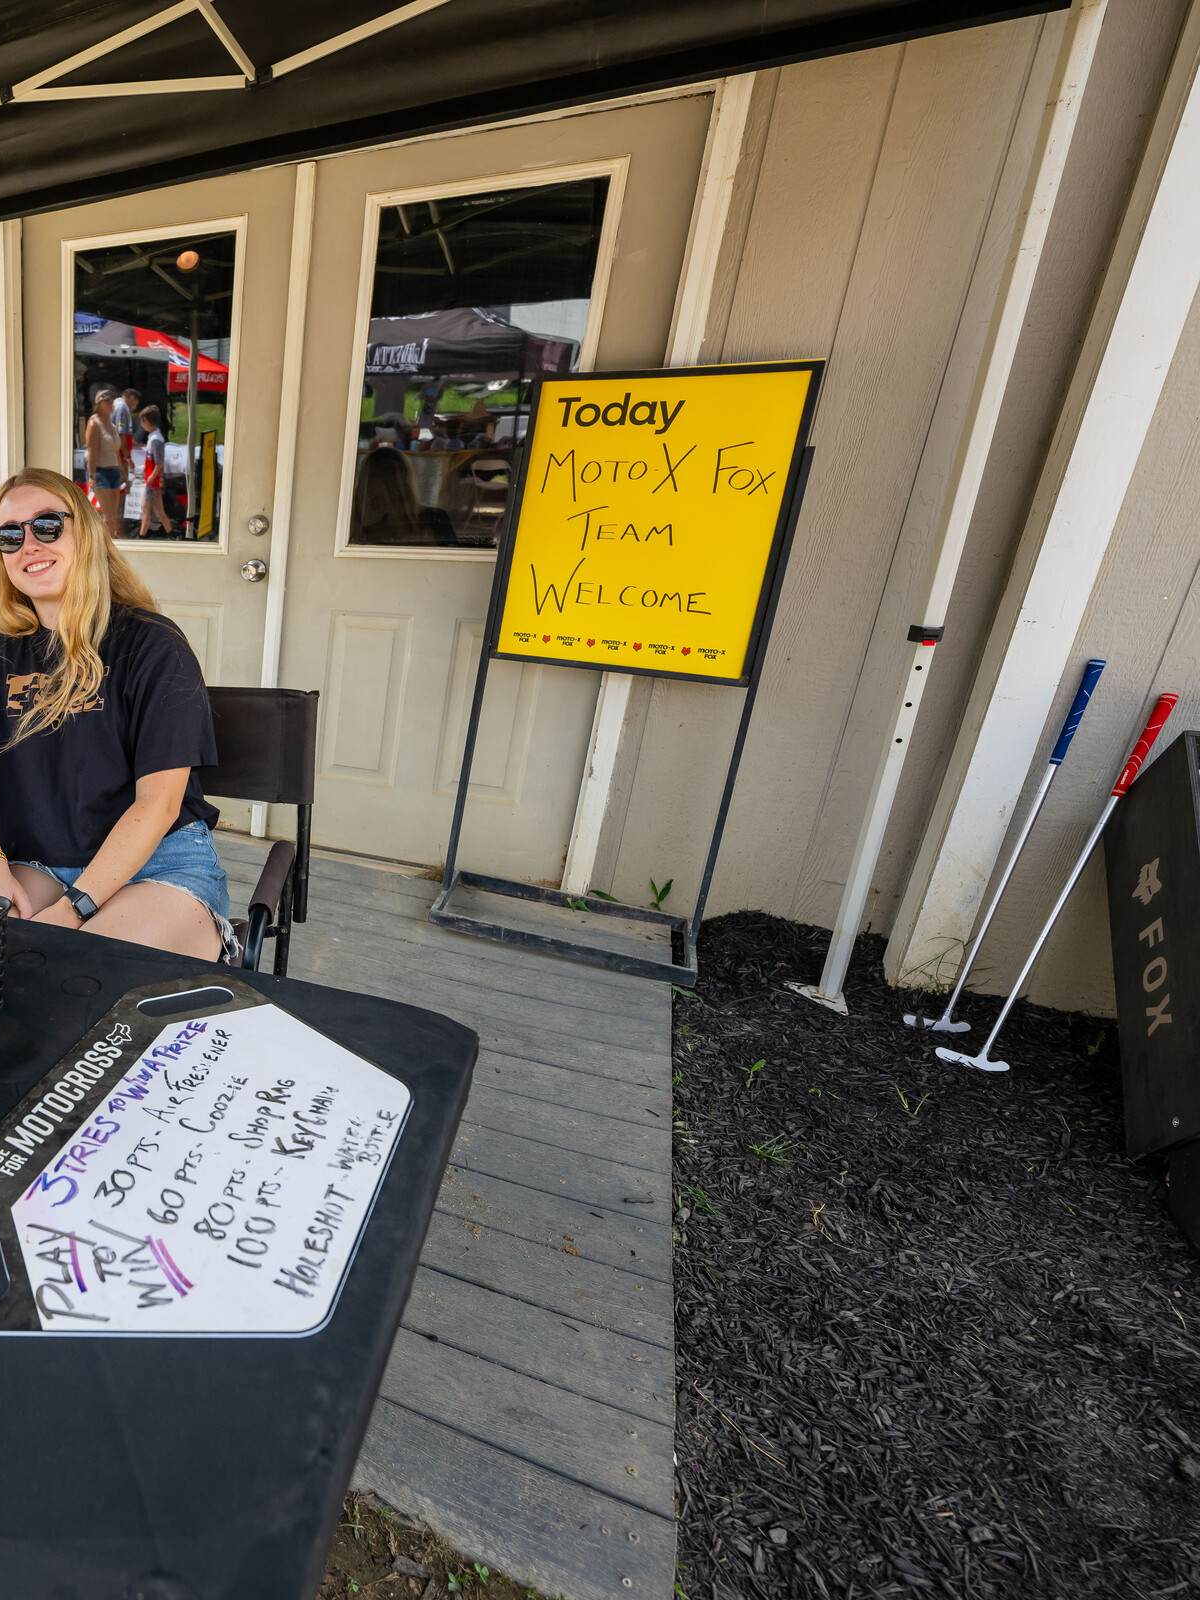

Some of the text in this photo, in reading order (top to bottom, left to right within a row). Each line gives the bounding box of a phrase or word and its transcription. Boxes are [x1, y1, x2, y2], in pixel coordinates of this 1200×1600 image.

[558, 392, 686, 434] Today
[712, 441, 776, 496] FOX
[567, 505, 673, 550] TEAM
[530, 558, 712, 615] WELCOME
[513, 631, 537, 639] MOTO-X
[1138, 917, 1173, 1037] FOX
[164, 1029, 232, 1091] FRESENER
[5, 1041, 123, 1156] MOTOCROSS
[25, 1021, 208, 1207] 3 TRIES TO WIN A PRIZE
[142, 1095, 194, 1123] AIR
[255, 1079, 296, 1104] RAG
[147, 1189, 185, 1224] 60
[179, 1076, 249, 1133] COOZIE
[228, 1106, 285, 1149] SHOP
[0, 1153, 28, 1177] FOR
[94, 1170, 135, 1208] 30
[193, 1202, 235, 1240] 80
[227, 1216, 276, 1268] 100
[273, 1183, 355, 1298] HOLESHOT
[27, 1223, 110, 1322] PLAY
[92, 1246, 122, 1282] TO
